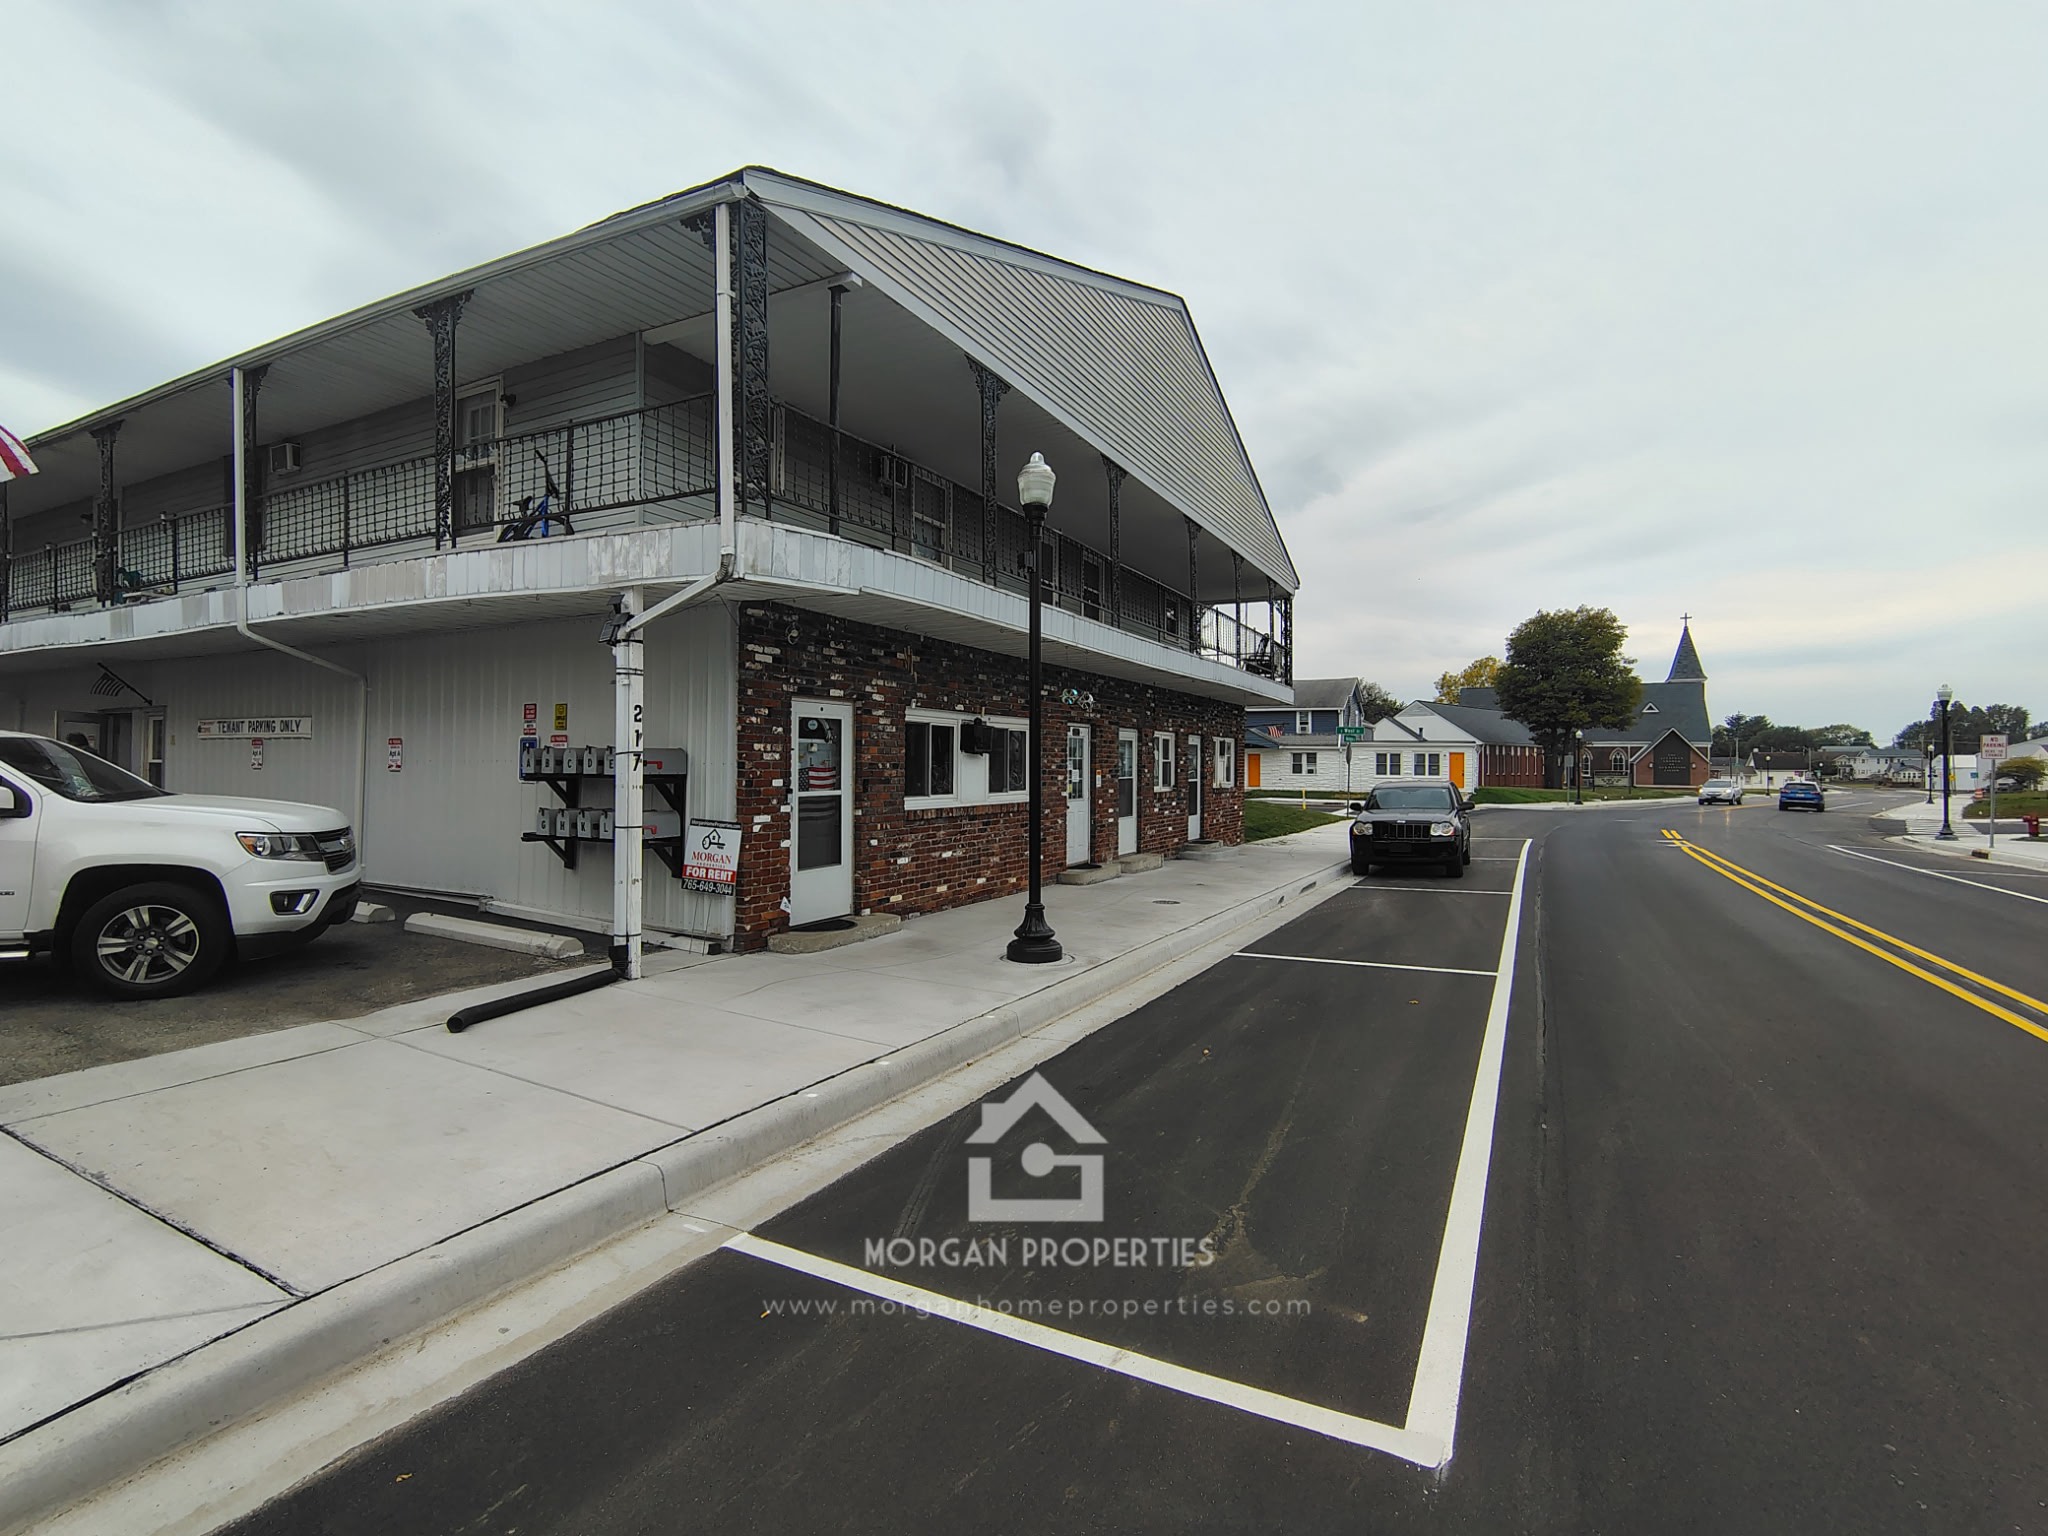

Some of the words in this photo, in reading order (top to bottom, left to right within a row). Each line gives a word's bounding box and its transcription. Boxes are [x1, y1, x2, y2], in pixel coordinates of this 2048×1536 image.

[217, 721, 245, 733] TENANT
[248, 720, 276, 733] PARKING
[280, 719, 302, 732] ONLY
[526, 758, 531, 768] A
[545, 758, 550, 768] B
[567, 759, 572, 768] C
[587, 758, 593, 768] D
[609, 758, 614, 769] E
[541, 820, 546, 829] G
[560, 821, 565, 831] H
[580, 821, 586, 831] K
[603, 822, 609, 832] L
[692, 851, 732, 864] MORGAN
[685, 866, 706, 878] FOR
[707, 868, 734, 882] RENT
[682, 879, 733, 895] 765-649-3044
